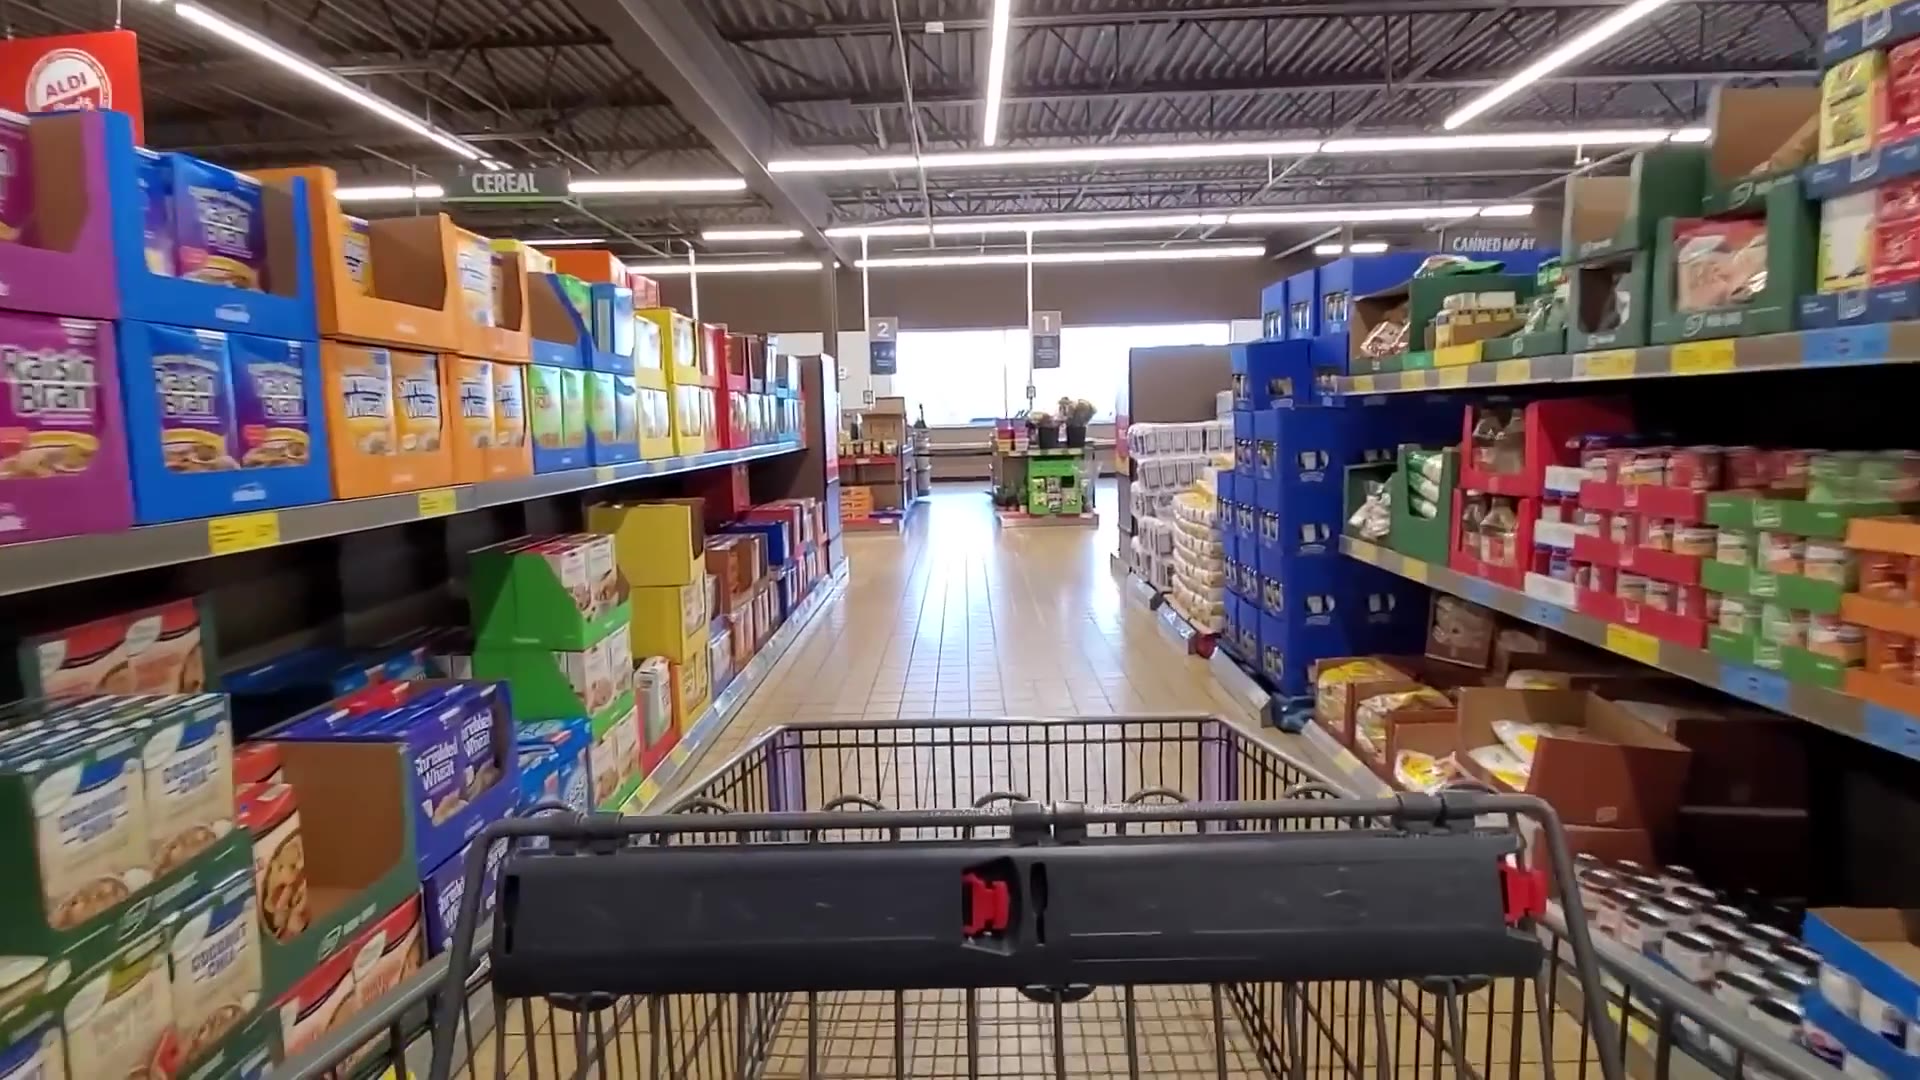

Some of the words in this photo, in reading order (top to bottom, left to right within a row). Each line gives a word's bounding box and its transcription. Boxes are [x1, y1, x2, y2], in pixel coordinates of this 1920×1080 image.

[46, 72, 87, 99] ALDI
[472, 173, 539, 193] CEREAL
[1453, 237, 1502, 252] CANNED
[877, 322, 890, 338] 2
[1042, 316, 1050, 332] 1
[14, 384, 92, 414] Bran
[414, 736, 459, 776] Shredded
[424, 758, 454, 790] Wheat
